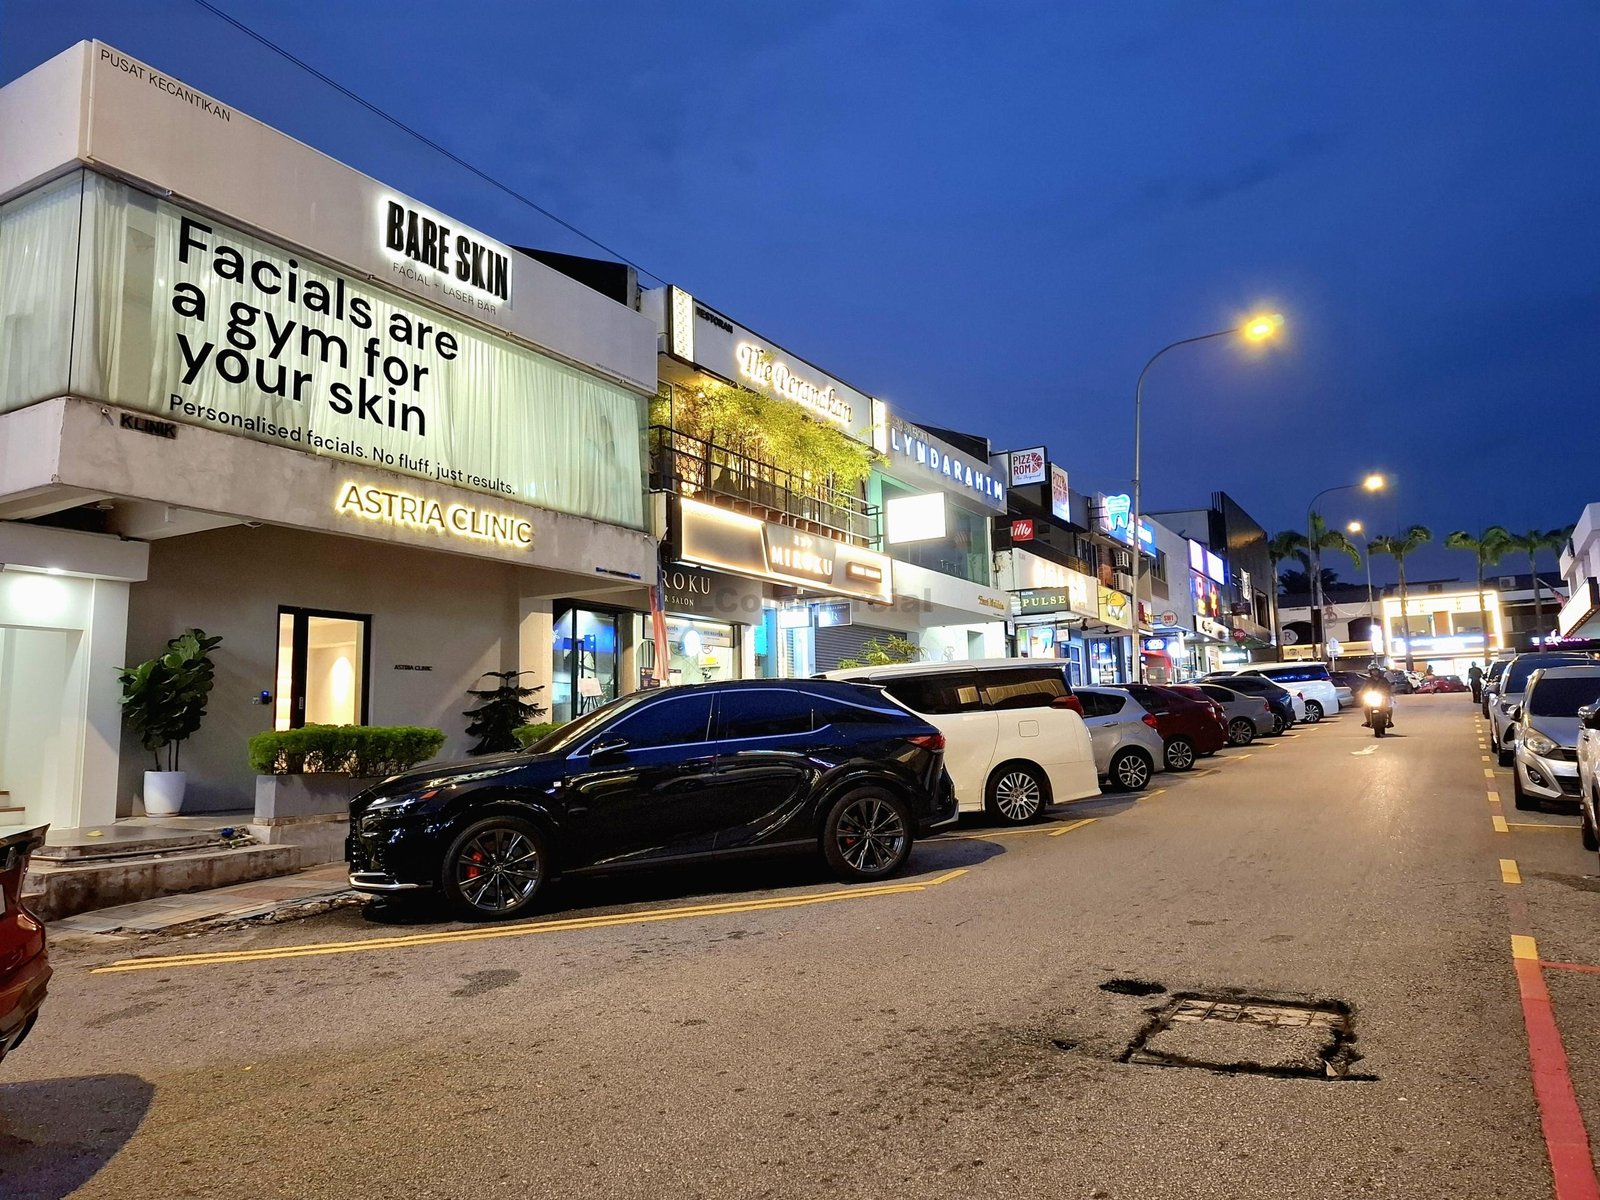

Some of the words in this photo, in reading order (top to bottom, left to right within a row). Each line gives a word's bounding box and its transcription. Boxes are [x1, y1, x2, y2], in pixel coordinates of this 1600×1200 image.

[100, 49, 145, 79] PUSAT
[149, 72, 231, 122] KECANTIKAN
[386, 200, 450, 275] BARE
[455, 235, 508, 301] SKIN
[178, 215, 373, 330] Facials
[388, 312, 459, 361] are
[392, 262, 430, 287] FACIAL
[443, 286, 474, 306] LASER
[477, 299, 497, 316] BAR
[171, 281, 207, 322] a
[226, 301, 348, 370] gym
[364, 337, 429, 393] for
[741, 346, 773, 382] The
[175, 332, 313, 402] your
[328, 376, 426, 437] skin
[120, 413, 176, 438] KLINIK
[169, 393, 302, 442] Personalised
[306, 430, 368, 459] facials.
[372, 446, 395, 465] No
[398, 454, 433, 477] fluff,
[435, 462, 464, 482] just
[467, 477, 516, 495] results.
[891, 427, 1003, 501] LYNDARAHIM
[341, 485, 446, 529] ASTRIA
[451, 507, 532, 544] CLINIC
[1014, 522, 1032, 538] illy
[672, 595, 694, 607] SALON
[1022, 595, 1066, 607] PULSE
[1284, 631, 1293, 641] R
